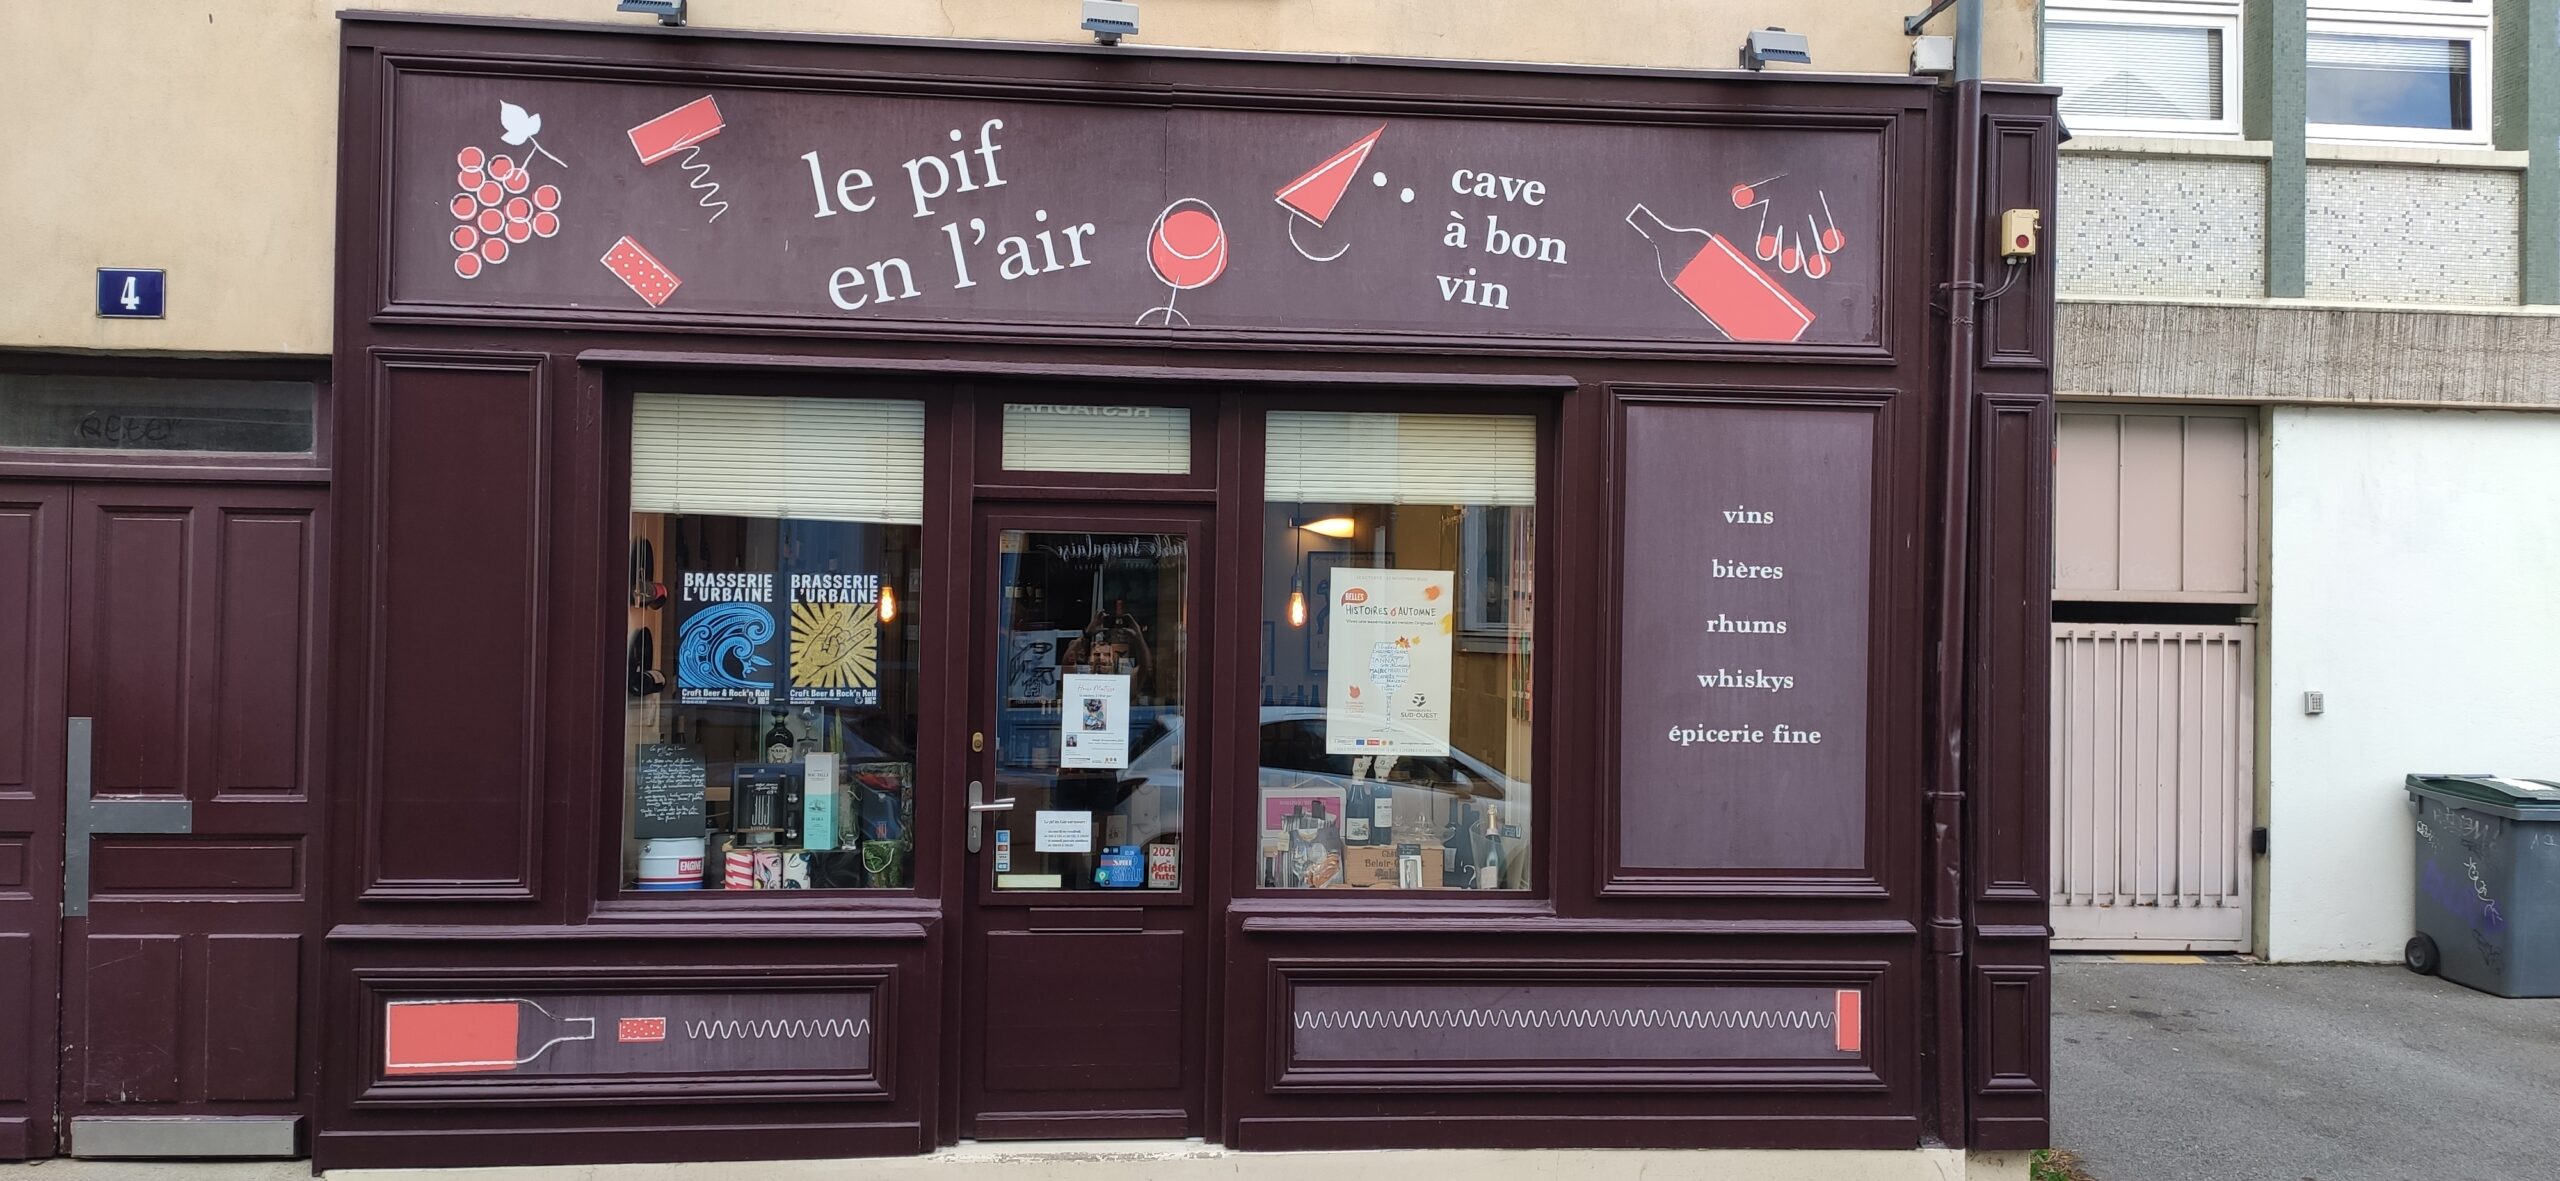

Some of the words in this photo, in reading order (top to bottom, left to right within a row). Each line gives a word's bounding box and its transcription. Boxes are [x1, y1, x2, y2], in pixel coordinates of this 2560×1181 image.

[801, 150, 876, 218] le
[902, 118, 1007, 218] pif
[1451, 169, 1546, 206] cave
[1443, 210, 1468, 249] à
[1485, 215, 1568, 264] bon
[828, 257, 921, 311] en
[941, 209, 1096, 290] l'air
[120, 276, 140, 310] 4
[1436, 267, 1510, 310] vin
[1722, 505, 1774, 525] vins
[1711, 558, 1784, 580] bières
[684, 572, 773, 588] BRASSERIE
[790, 574, 878, 589] BRASSERIE
[683, 587, 773, 602] L'URBAINE
[790, 588, 878, 603] L'URBAINE
[1346, 604, 1388, 616] HISTOIRES
[1706, 613, 1787, 634] rhums
[1697, 668, 1794, 693] whiskys
[681, 688, 702, 697] Craft
[703, 689, 721, 697] Beer
[755, 689, 770, 697] Roll
[789, 689, 810, 698] Craft
[811, 689, 828, 698] Beer
[862, 690, 877, 698] Roll
[1668, 723, 1764, 747] épicerie
[1772, 723, 1822, 744] fine
[1152, 847, 1176, 857] 2021
